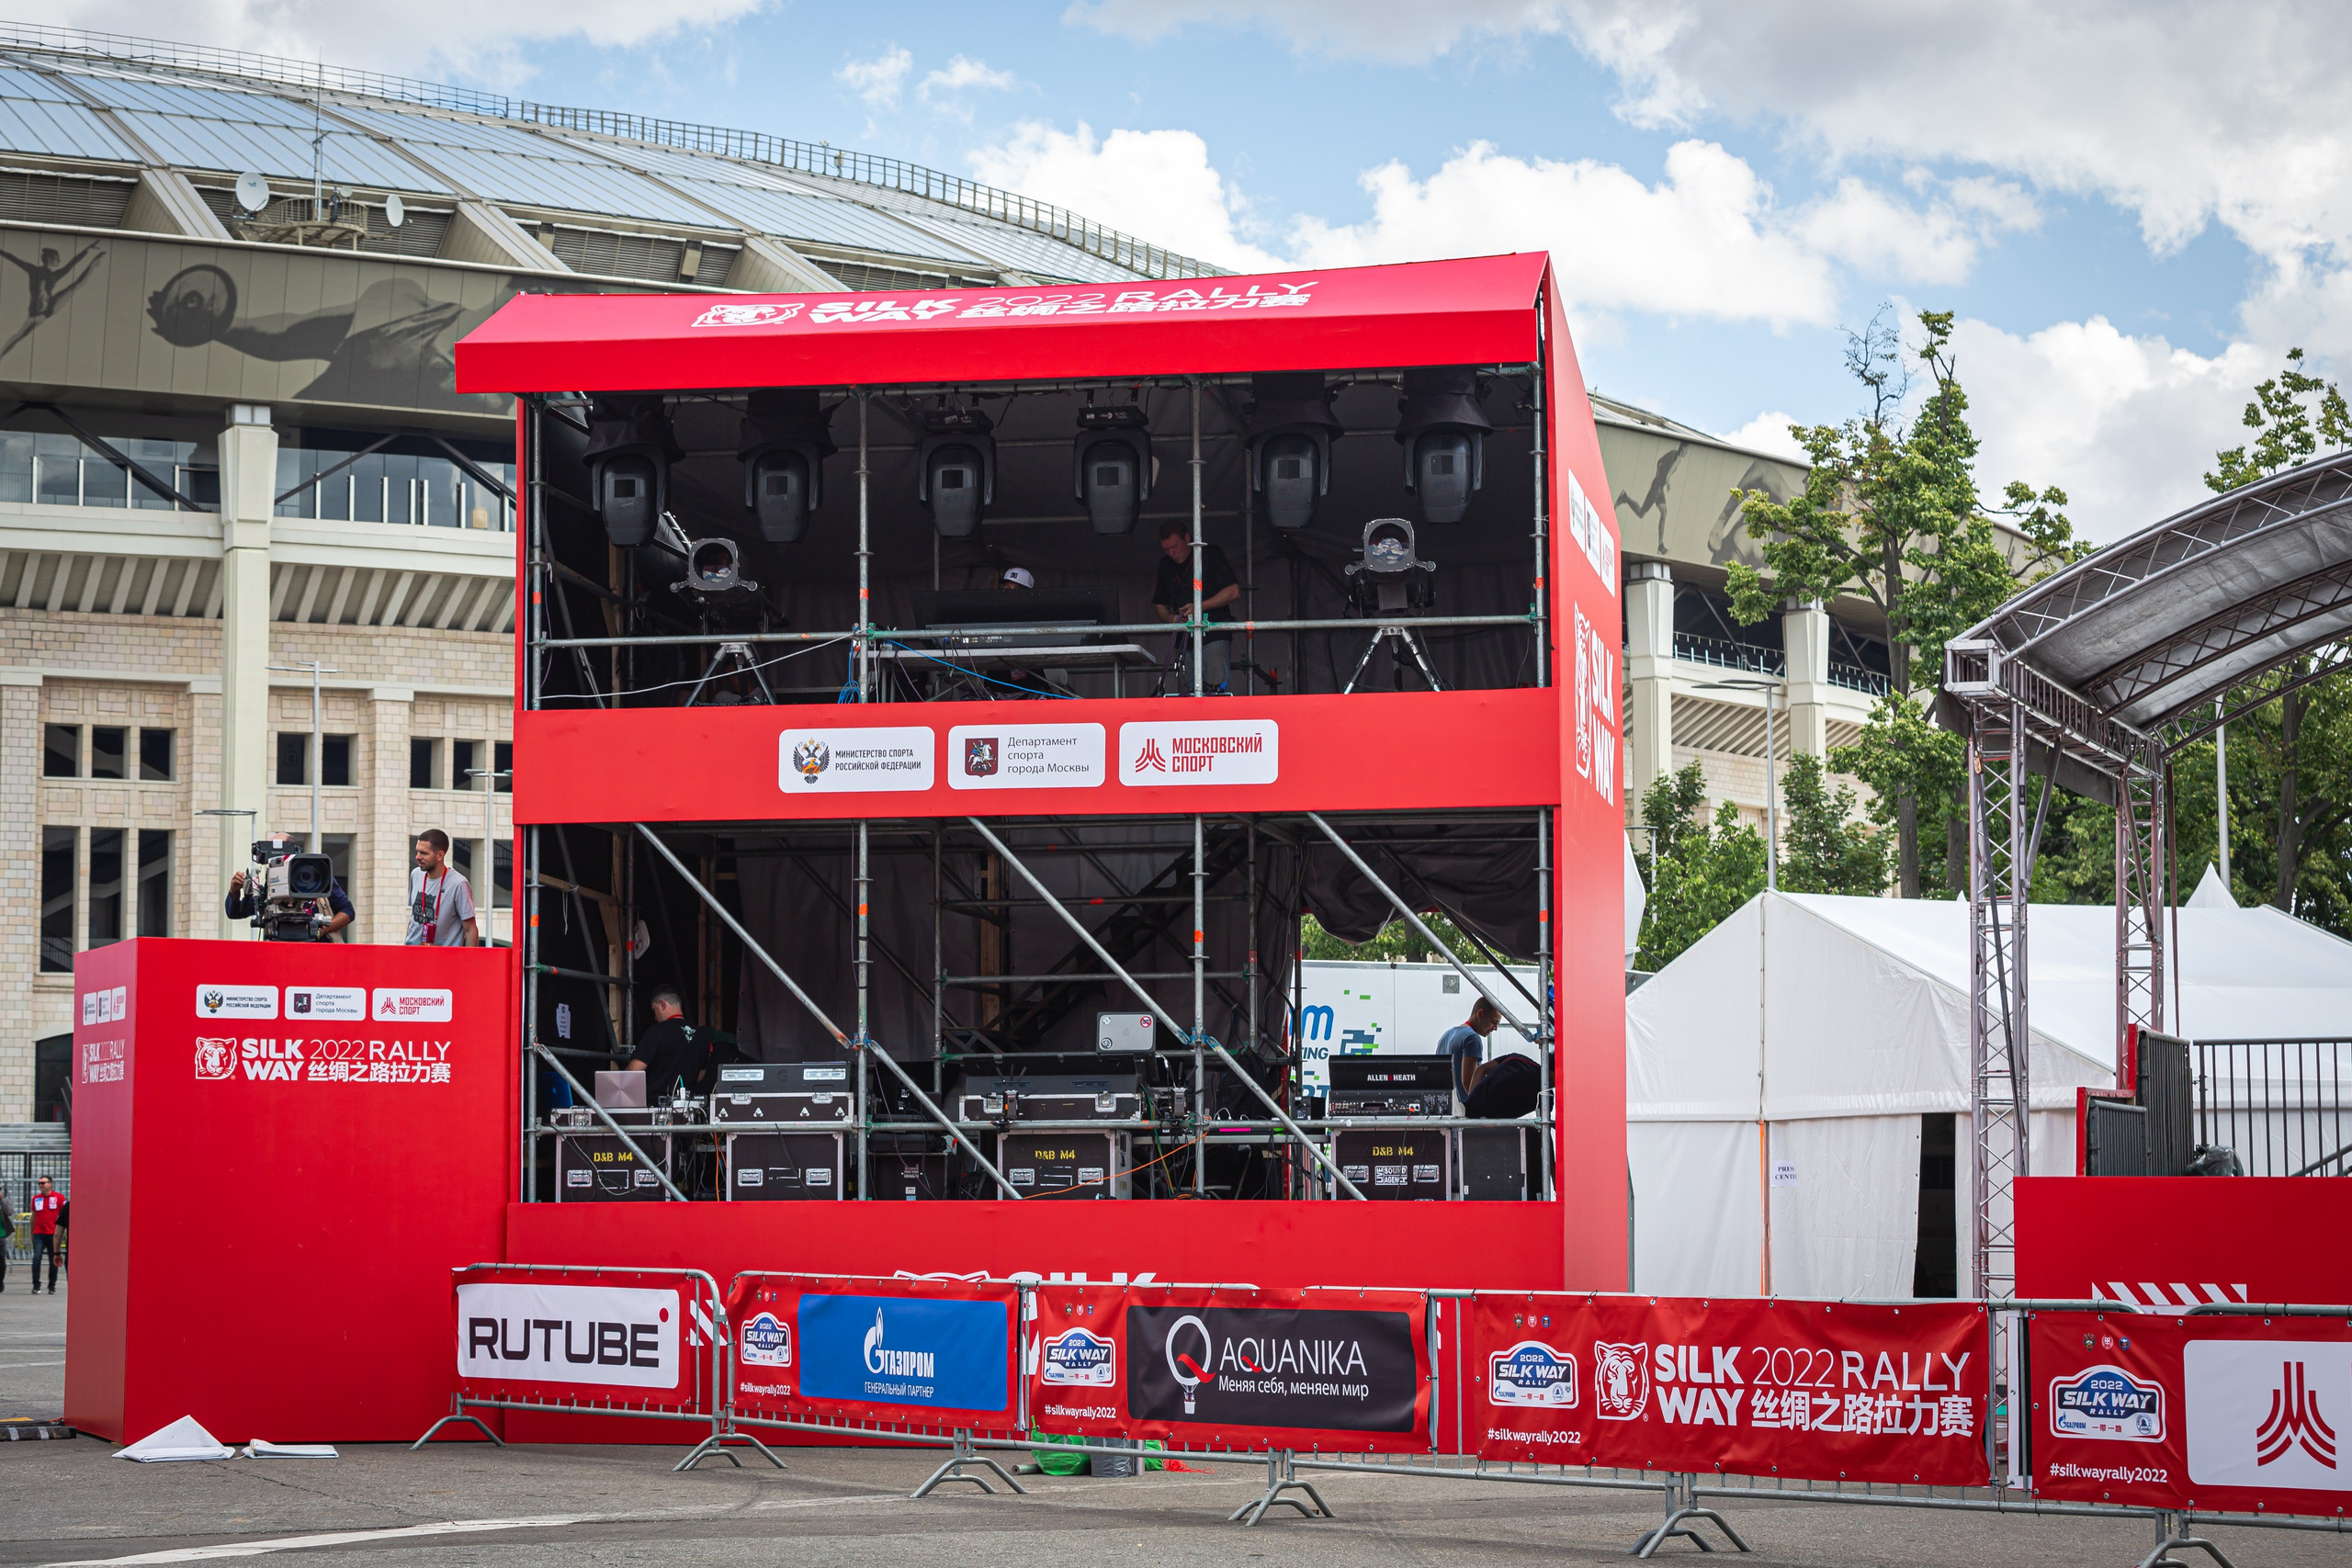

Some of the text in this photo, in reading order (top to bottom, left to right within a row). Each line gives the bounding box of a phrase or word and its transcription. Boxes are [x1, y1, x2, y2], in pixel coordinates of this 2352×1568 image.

[811, 281, 1319, 313] SILK 2022 RALLY
[956, 294, 1311, 318] 丝绸之路拉力赛
[808, 310, 954, 323] WAY
[1591, 628, 1615, 728] SILK
[1008, 737, 1078, 748] Департамент
[1172, 733, 1262, 753] МОСКОВСКИЙ
[835, 749, 914, 759] МИНИСТЕРСТВО СПОРТА
[1007, 751, 1044, 761] спорта
[1593, 713, 1615, 807] WAY
[835, 761, 922, 771] РОССИЙСКОЙ ФЕДЕРАЦИИ
[1008, 763, 1089, 775] города Москвы
[1172, 755, 1214, 773] СПОРТ
[399, 996, 445, 1007] МОСКОВСКИЙ
[399, 1006, 421, 1015] СПОРТ
[242, 1038, 452, 1061] SILK 2022 RALLY
[1301, 1047, 1329, 1059] ING
[242, 1060, 305, 1081] WAY
[307, 1061, 451, 1084] 丝绸之路拉力赛
[594, 1152, 633, 1162] D&B M4
[1035, 1149, 1075, 1160] D&B M4
[1373, 1146, 1414, 1156] D&B M4
[469, 1317, 660, 1368] RUTUBE
[747, 1331, 785, 1343] SILK WAY
[1049, 1348, 1108, 1360] SILK WAY
[1219, 1337, 1367, 1376] AQUANIKA
[1520, 1354, 1544, 1362] 2022
[885, 1350, 933, 1378] ГАЗПРОМ
[1498, 1364, 1567, 1379] SILK WAY
[1655, 1344, 1970, 1391] SILK 2022 RALLY
[741, 1382, 790, 1396] #silkwayrally2022
[865, 1382, 933, 1398] ГЕНЕРАЛЬНЫЙ ПАРТНЕР
[1218, 1375, 1369, 1401] Меняя себя, меняем мир
[2090, 1380, 2123, 1390] 2022
[1656, 1385, 1745, 1426] WAY
[2063, 1391, 2152, 1409] SILK WAY
[1045, 1404, 1116, 1419] #silkwayrally2022
[1751, 1388, 1974, 1438] 丝绸之路拉力赛
[1487, 1427, 1580, 1446] #silkwayrally2022
[2050, 1462, 2167, 1483] #silkwayrally2022
